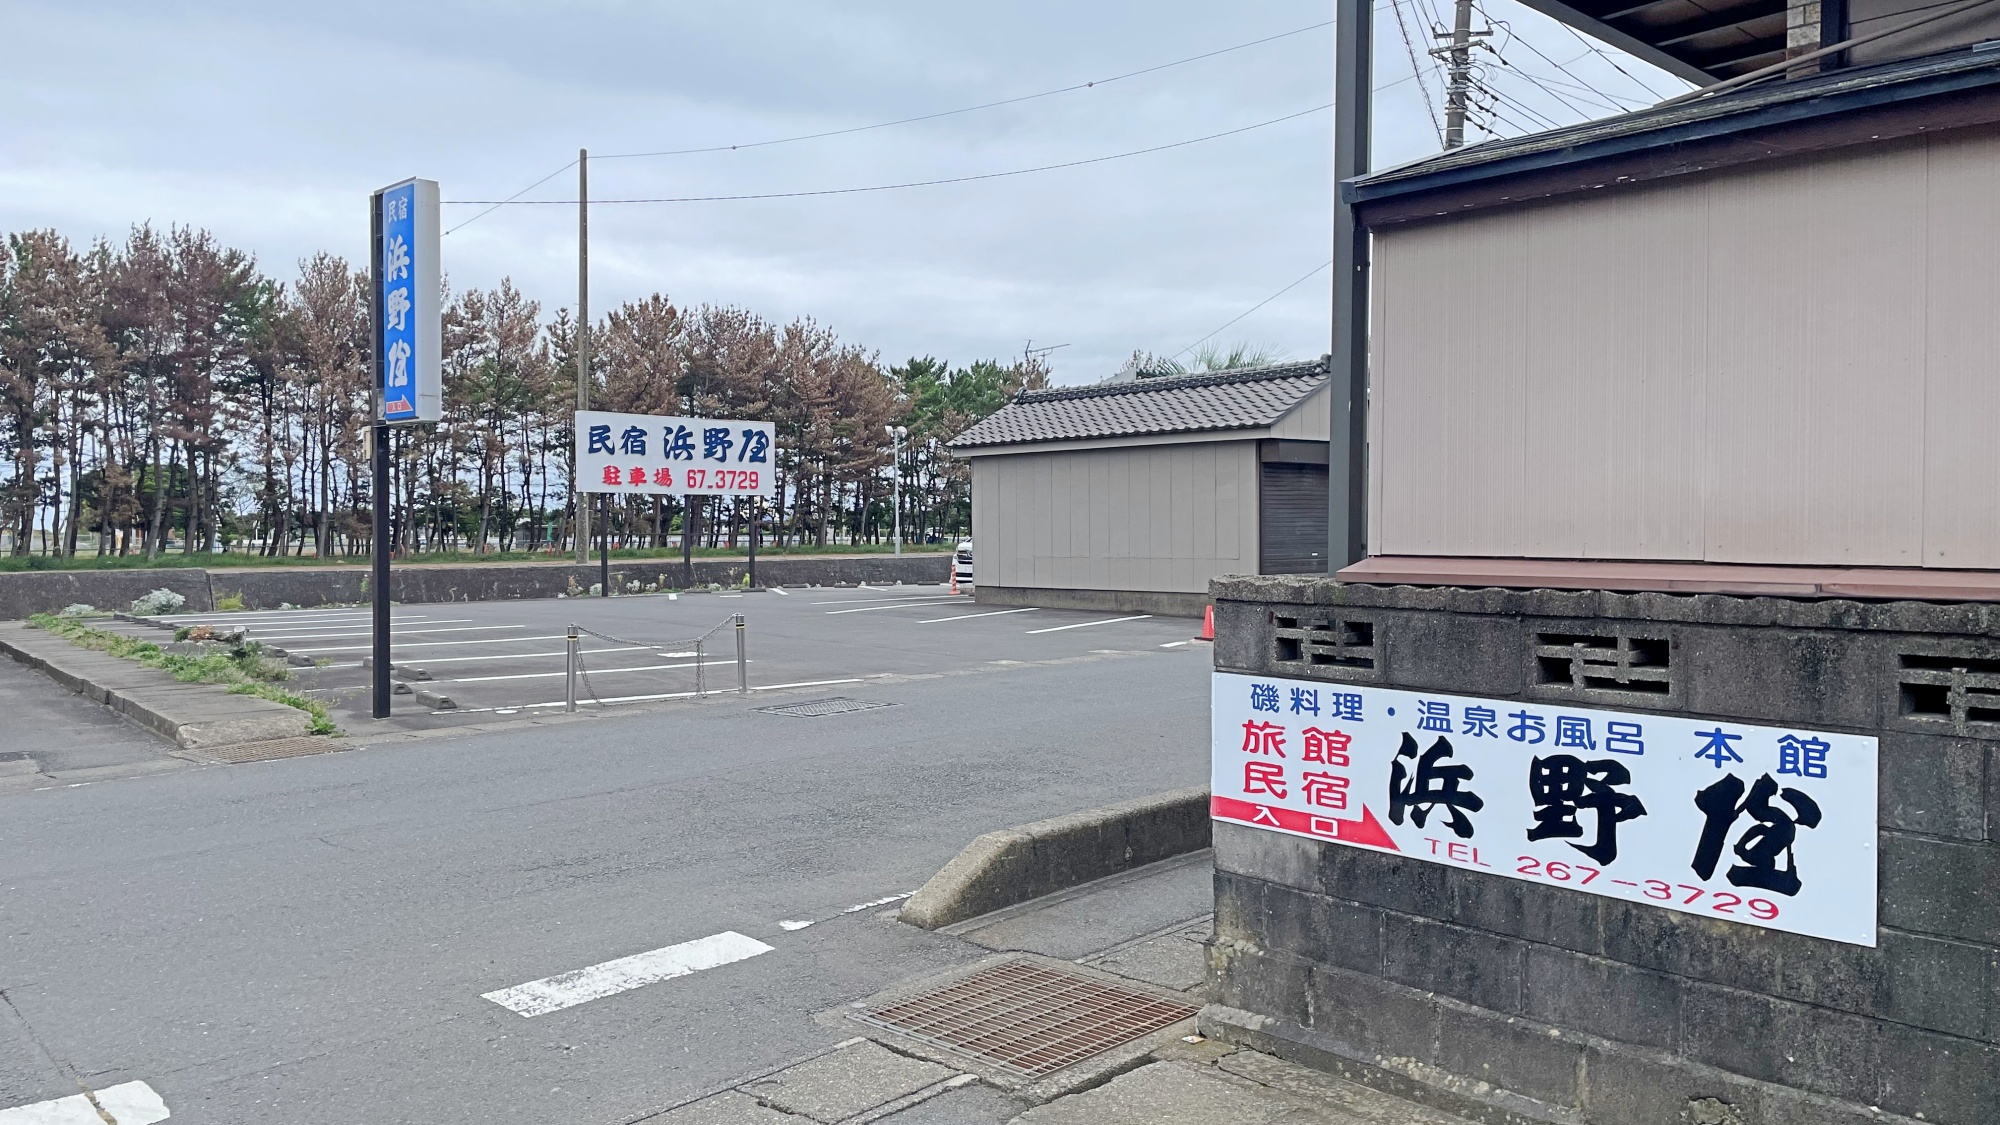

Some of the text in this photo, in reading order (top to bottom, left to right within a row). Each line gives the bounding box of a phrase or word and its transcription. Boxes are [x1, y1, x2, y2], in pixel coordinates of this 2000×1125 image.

[388, 196, 408, 222] 民宿
[588, 424, 770, 464] 民宿 浜野屋
[602, 465, 673, 488] 駐車場
[1242, 719, 1353, 768] 旅館
[1242, 761, 1350, 811] 民宿
[1252, 805, 1339, 838] 入口
[1388, 731, 1823, 897] 浜野屋
[1424, 837, 1780, 921] TEL 267-3729
